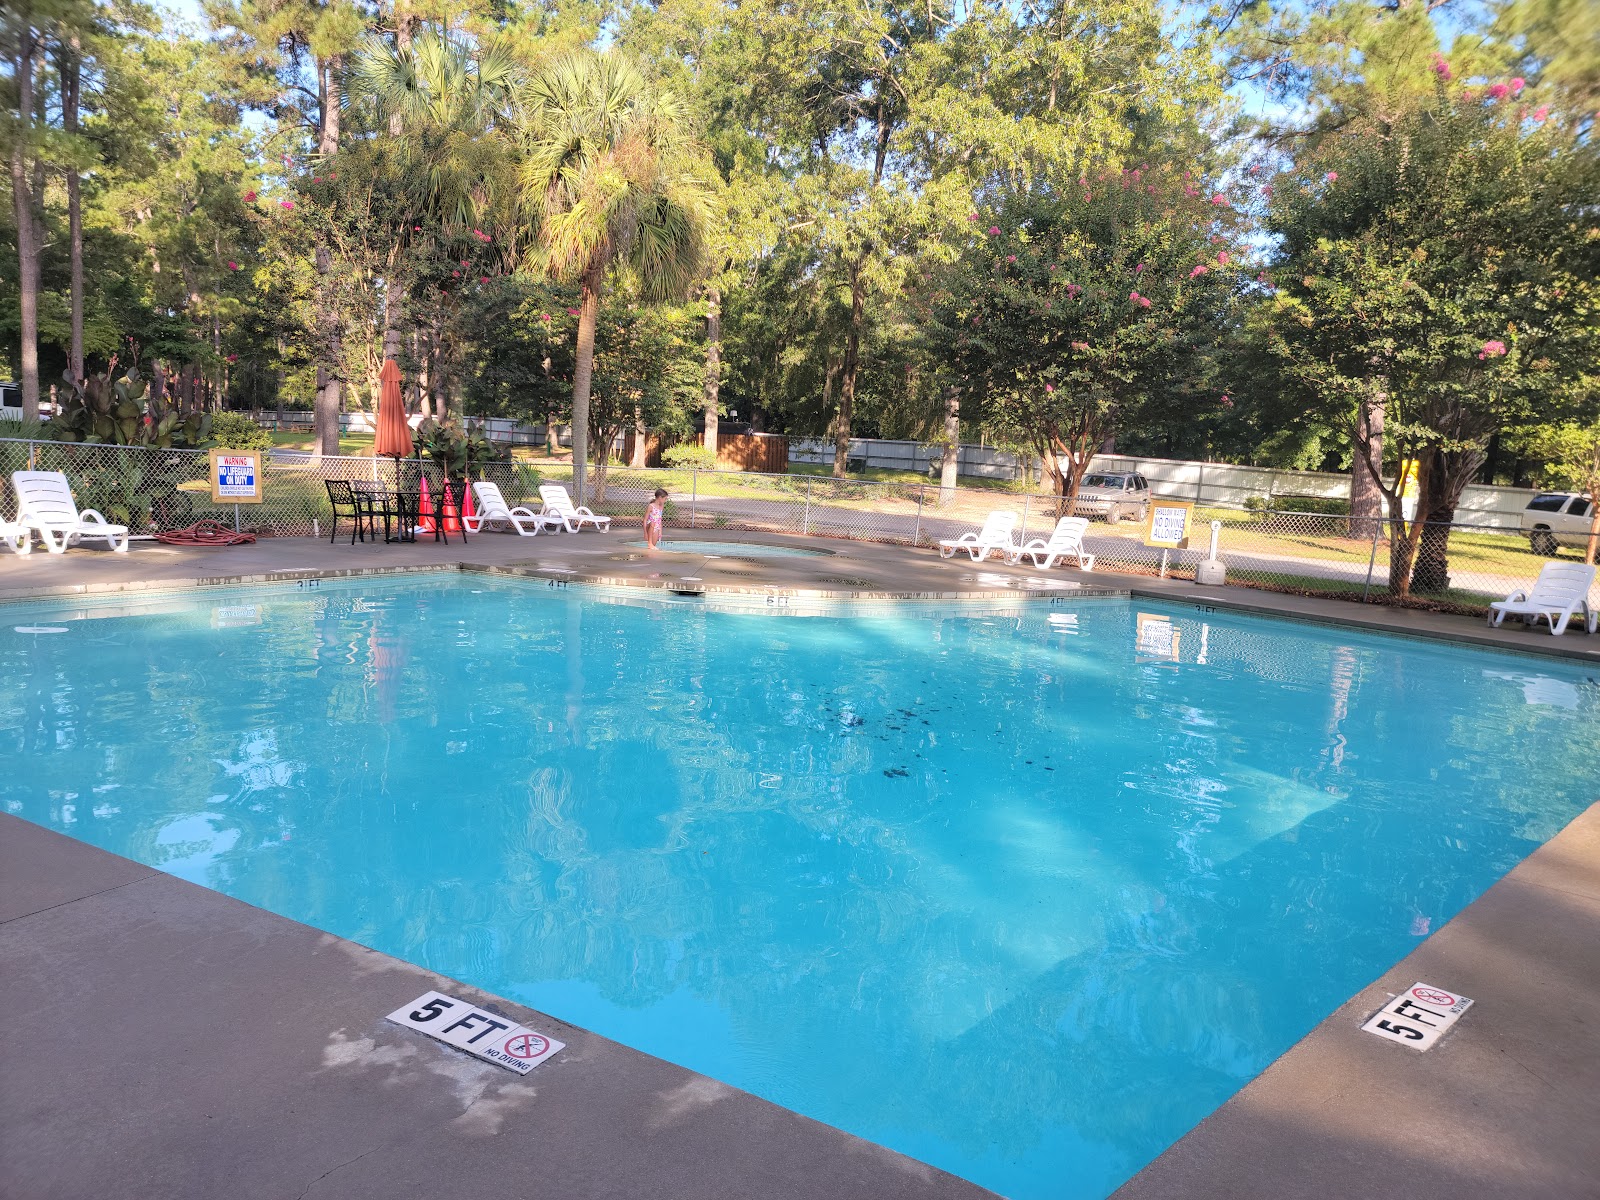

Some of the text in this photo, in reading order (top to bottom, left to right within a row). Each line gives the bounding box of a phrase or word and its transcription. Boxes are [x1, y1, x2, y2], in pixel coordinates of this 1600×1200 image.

[224, 456, 248, 466] WARNING
[219, 466, 253, 477] NO LIFEGUARD
[226, 475, 247, 485] ON DUTY
[1153, 516, 1185, 529] NO DIVING
[1152, 528, 1183, 540] ALLOWED
[409, 998, 509, 1044] 5 FT
[1376, 999, 1446, 1041] 5 FT
[484, 1048, 531, 1071] NO DIVING
